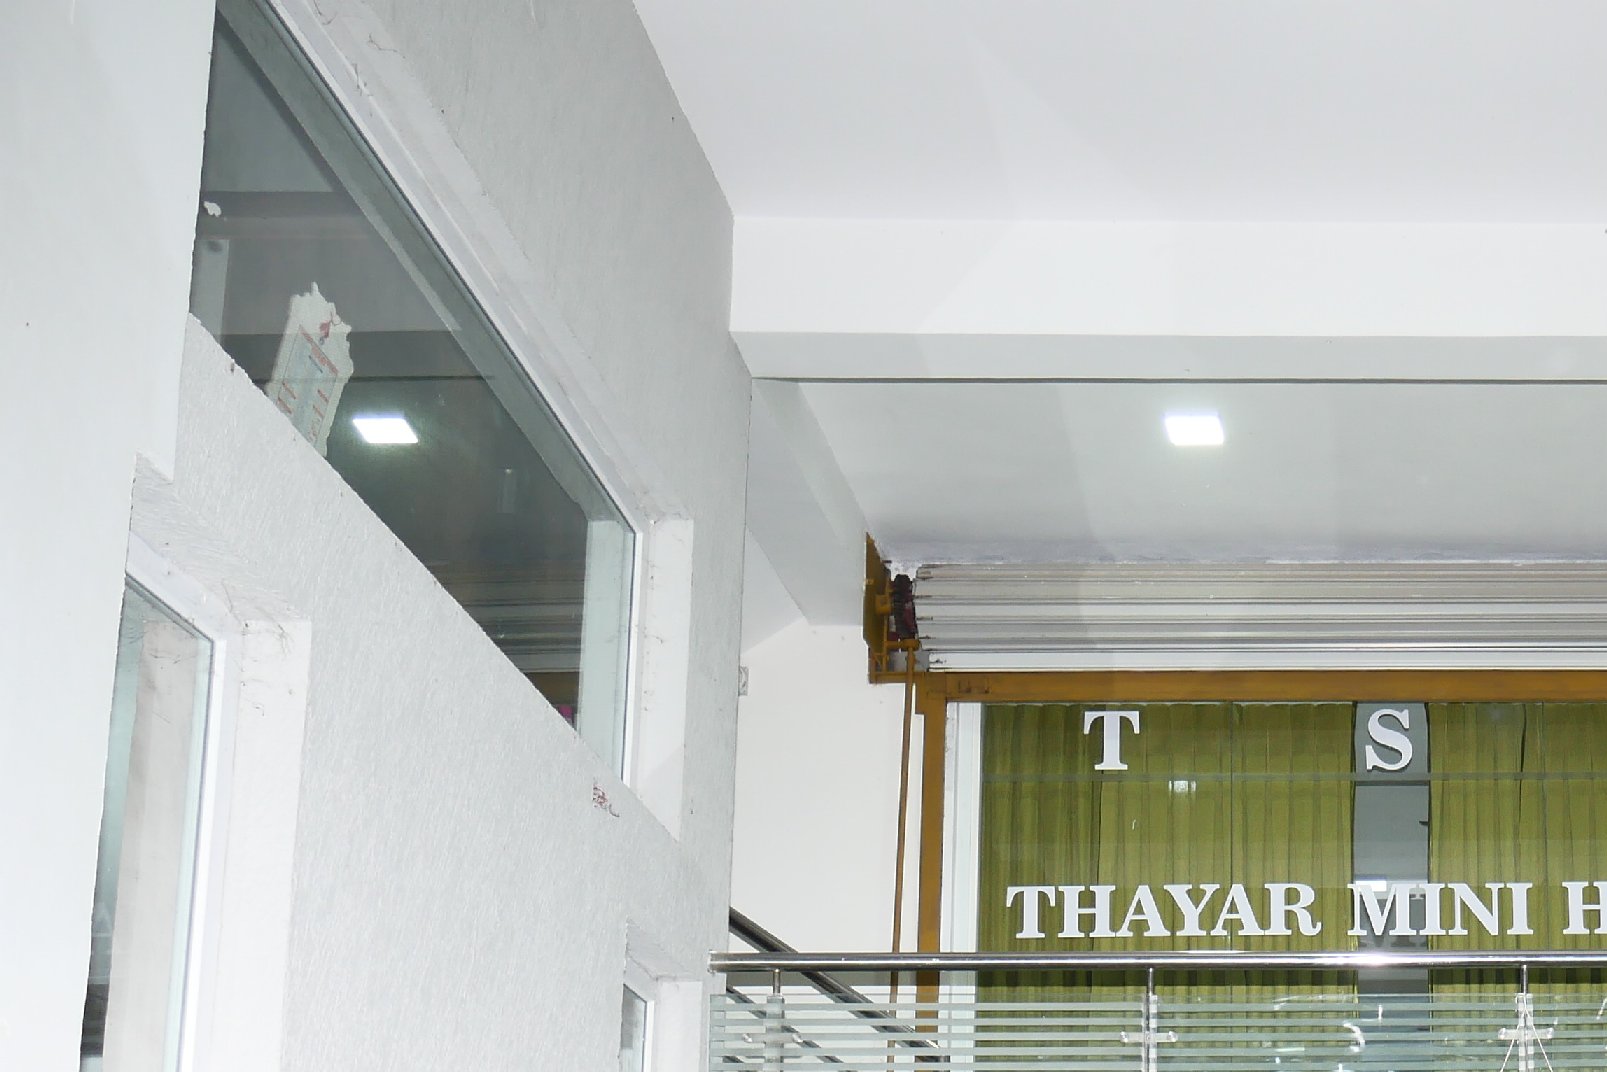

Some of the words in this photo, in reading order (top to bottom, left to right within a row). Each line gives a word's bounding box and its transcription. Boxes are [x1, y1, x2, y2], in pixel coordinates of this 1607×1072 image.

[1083, 710, 1140, 771] T
[1365, 708, 1413, 772] S
[1006, 883, 1322, 939] THAYAR
[1347, 882, 1534, 937] MINI
